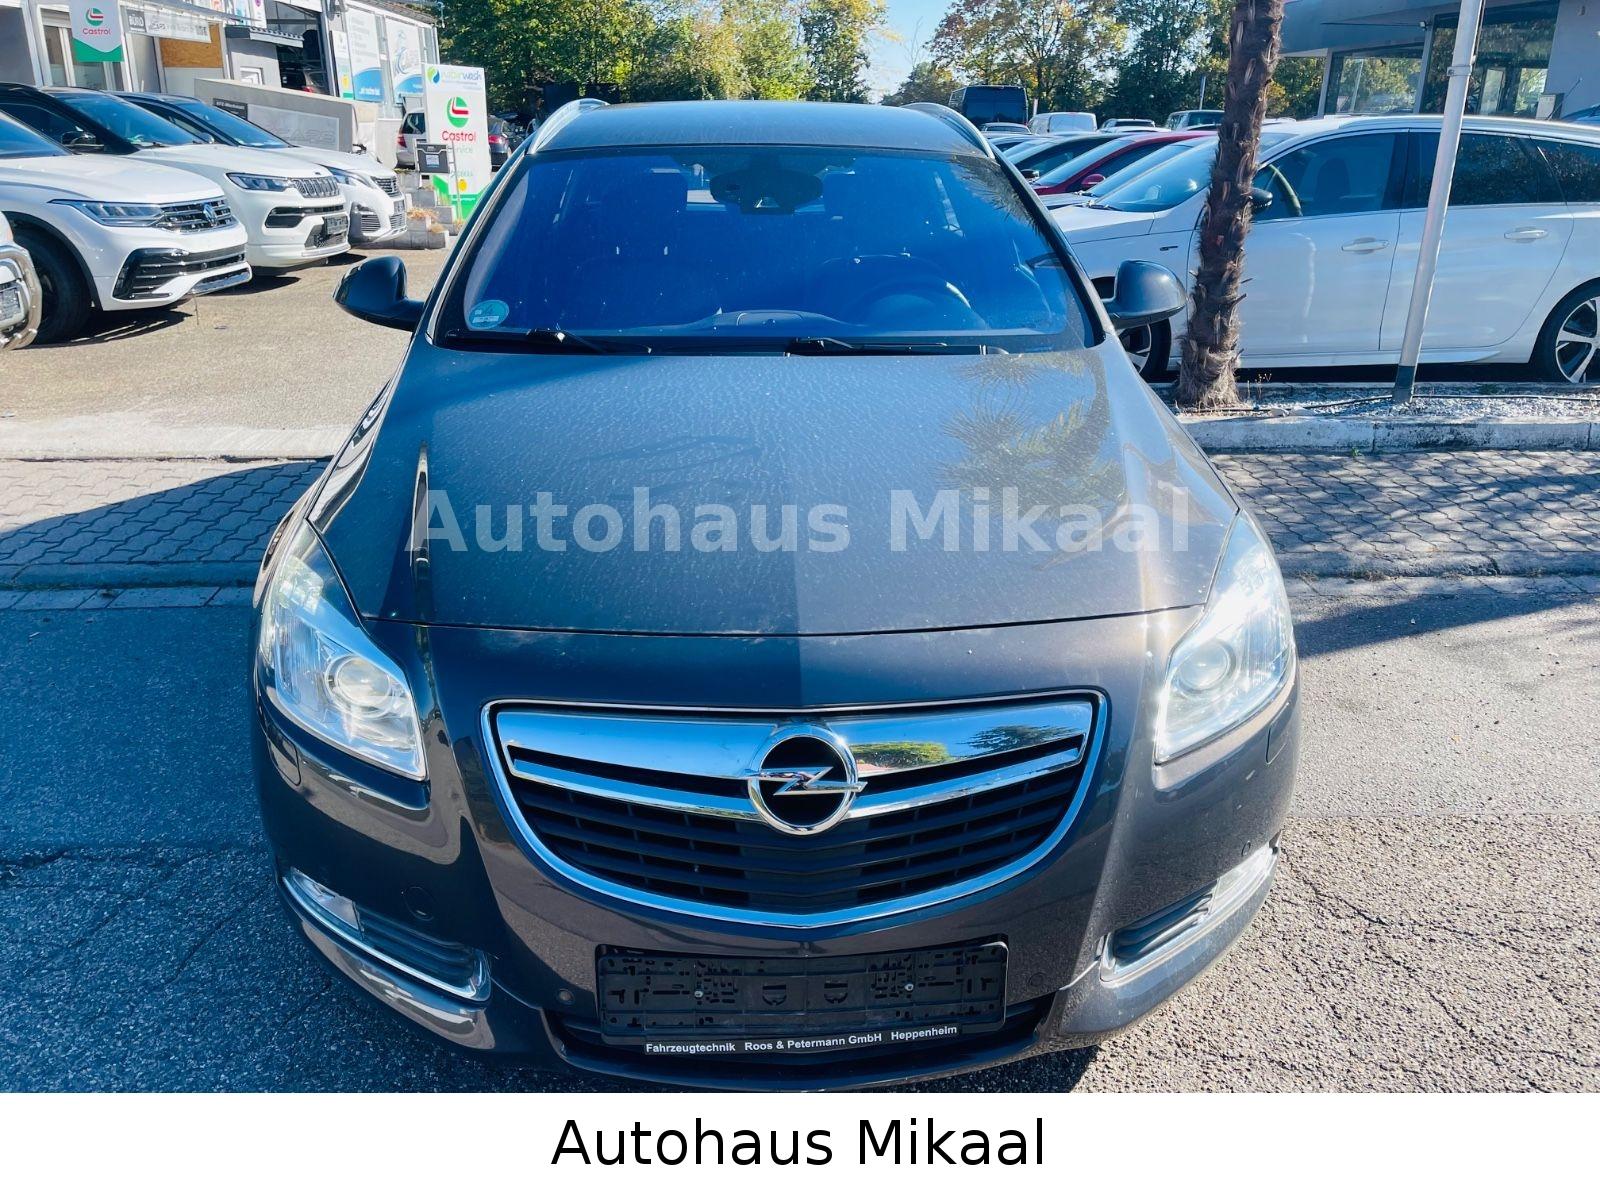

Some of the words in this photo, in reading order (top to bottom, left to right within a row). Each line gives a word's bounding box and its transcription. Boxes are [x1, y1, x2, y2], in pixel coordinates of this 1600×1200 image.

[82, 28, 111, 36] Castrol
[441, 130, 477, 142] Castrol
[646, 1042, 736, 1054] Fahrzeugtechnik
[744, 1041, 773, 1051] Roos
[776, 1040, 785, 1050] &
[787, 1037, 846, 1050] Petermann
[848, 1032, 882, 1045] GmbH
[891, 1026, 957, 1041] Heppenheim
